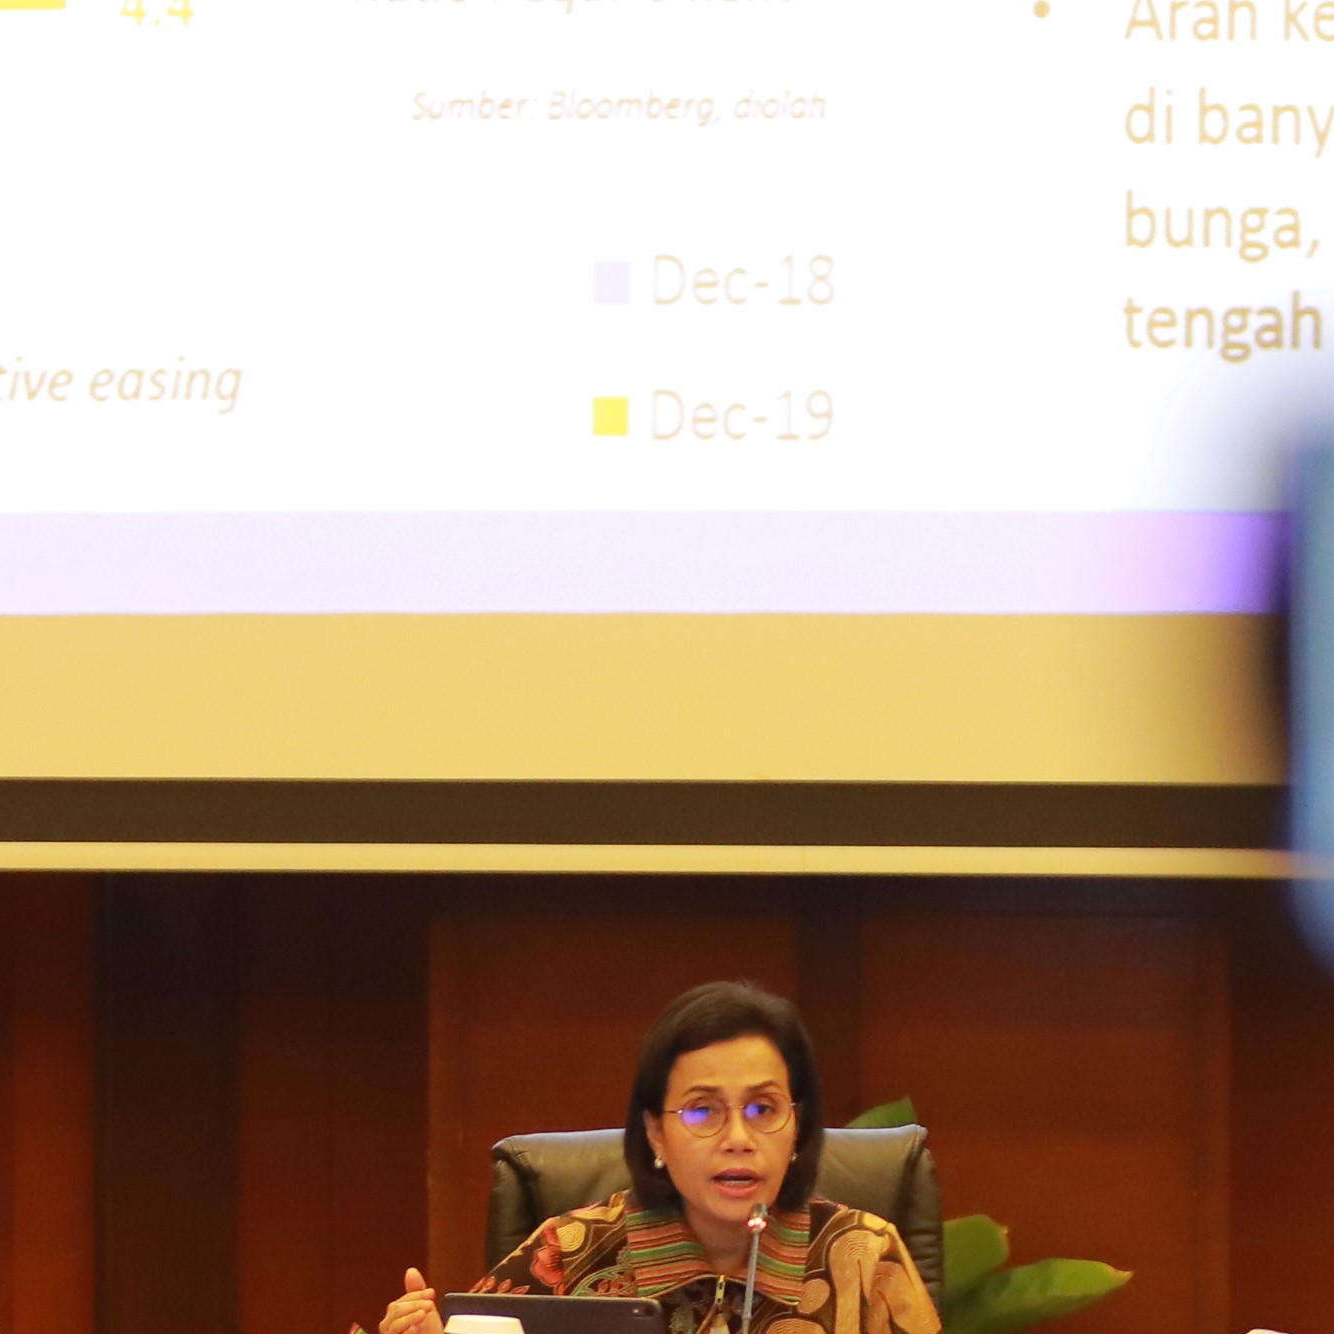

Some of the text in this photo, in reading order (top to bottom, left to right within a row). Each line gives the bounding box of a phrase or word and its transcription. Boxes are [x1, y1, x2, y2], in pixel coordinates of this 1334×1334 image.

[1124, 86, 1174, 146] di
[1125, 189, 1320, 265] bunga,
[652, 253, 835, 307] Dec-18
[1122, 290, 1323, 365] tengah
[87, 354, 244, 416] easing
[651, 388, 835, 443] Dec-19
